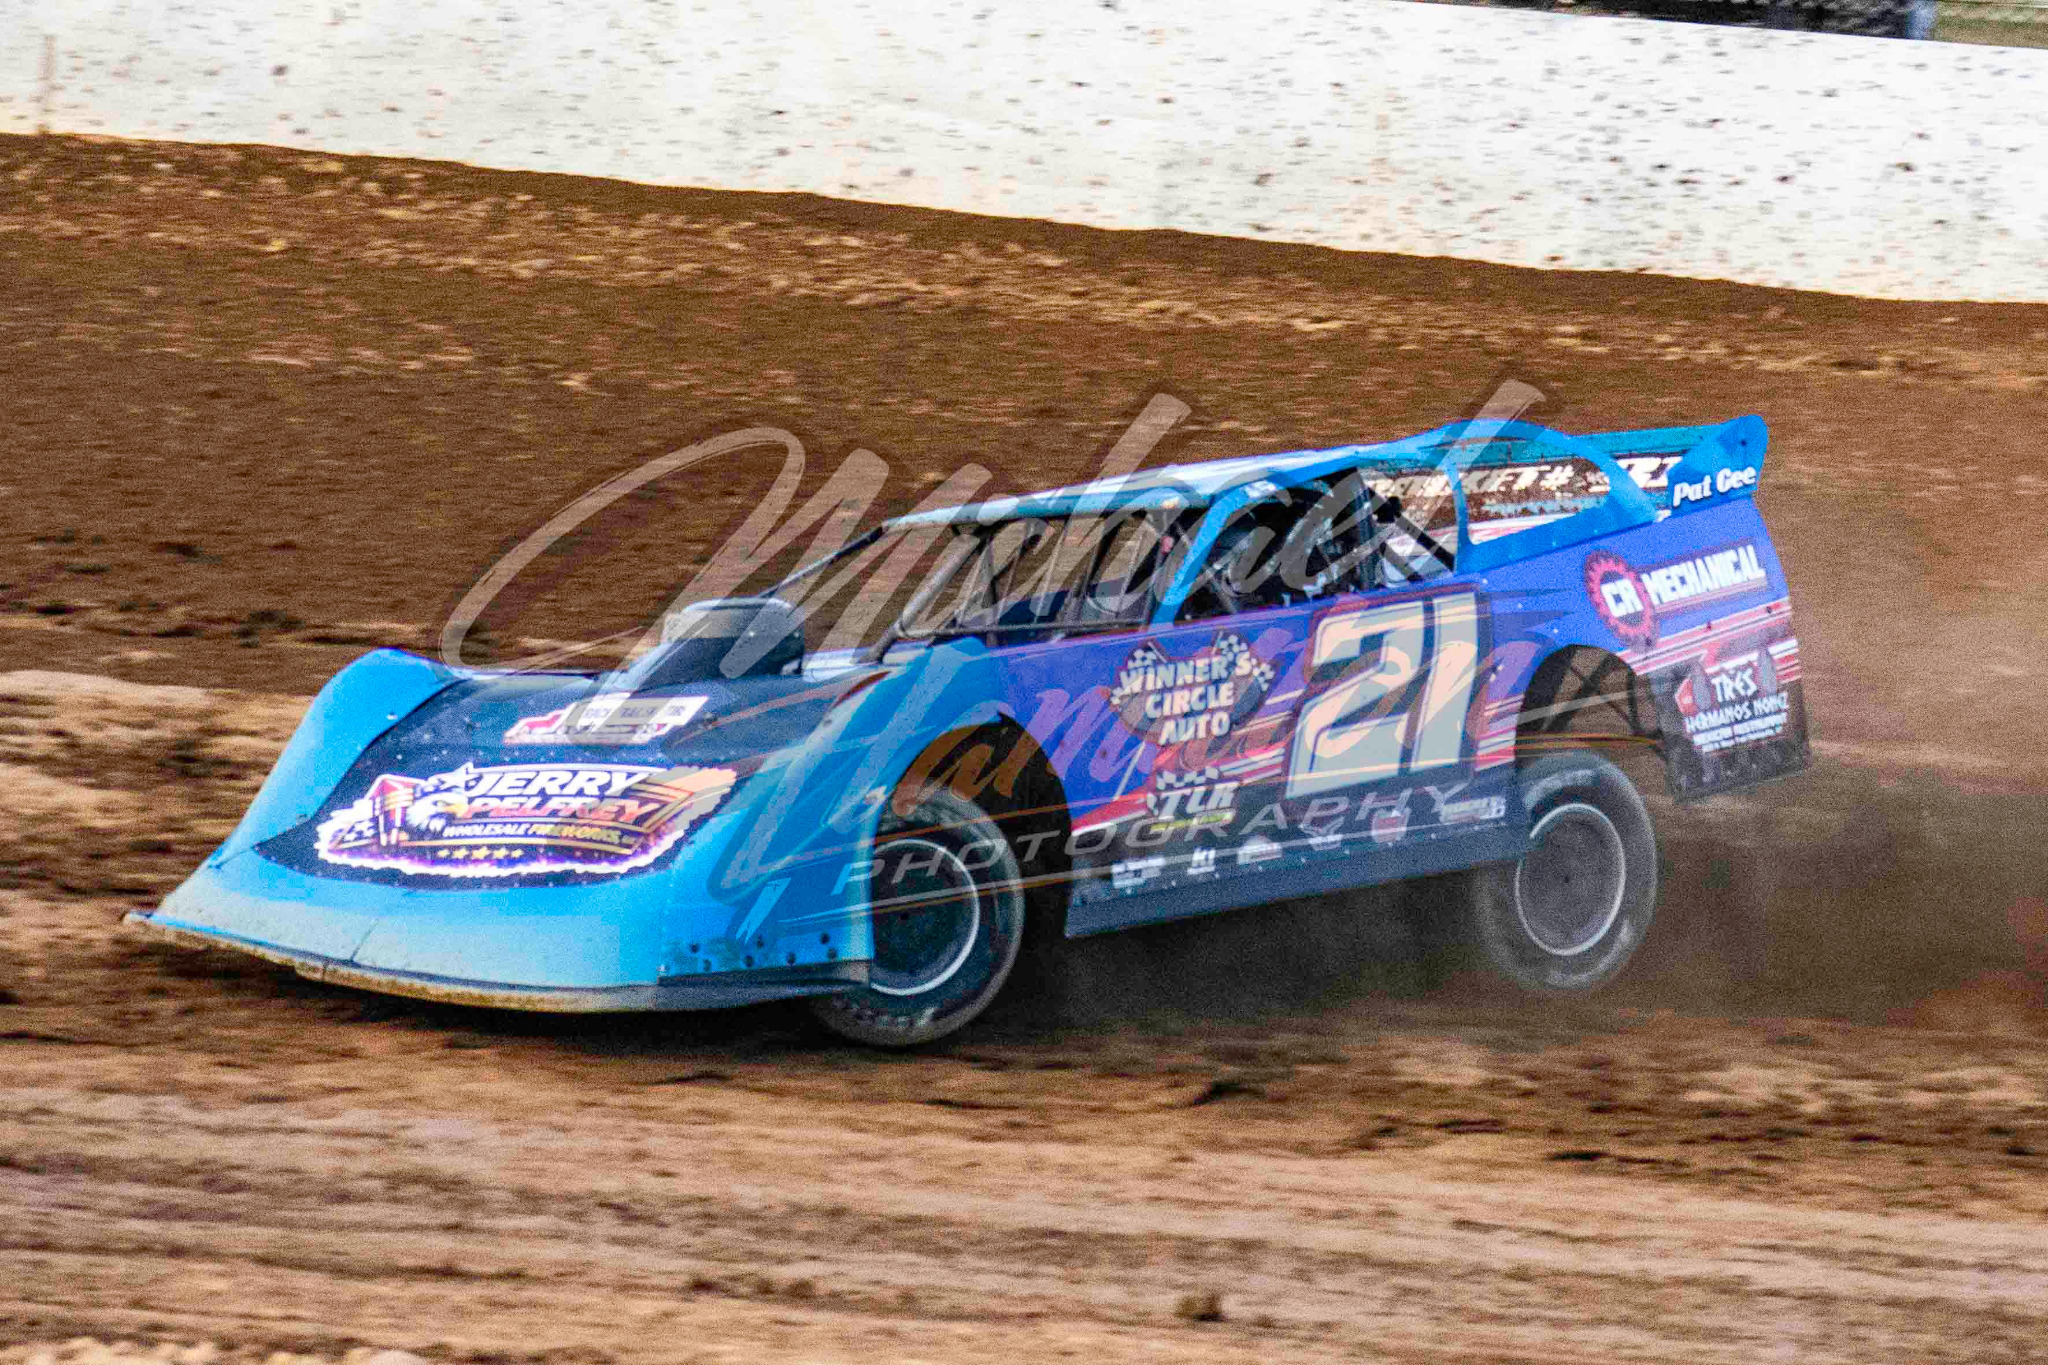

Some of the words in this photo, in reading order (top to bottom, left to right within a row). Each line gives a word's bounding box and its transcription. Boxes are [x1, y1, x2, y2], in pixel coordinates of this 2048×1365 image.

[1672, 474, 1713, 508] Pat
[1715, 465, 1758, 494] Gee
[1640, 544, 1767, 606] MECHANICAL
[1118, 651, 1253, 695] WINNER'S
[1711, 667, 1758, 703] TRES
[1145, 681, 1235, 719] CIRCLE
[1285, 591, 1478, 800] 21
[1157, 711, 1231, 746] AUTO
[465, 770, 650, 798] JERRY
[461, 796, 660, 824] PELFREY
[443, 824, 529, 839] WHOLESALE
